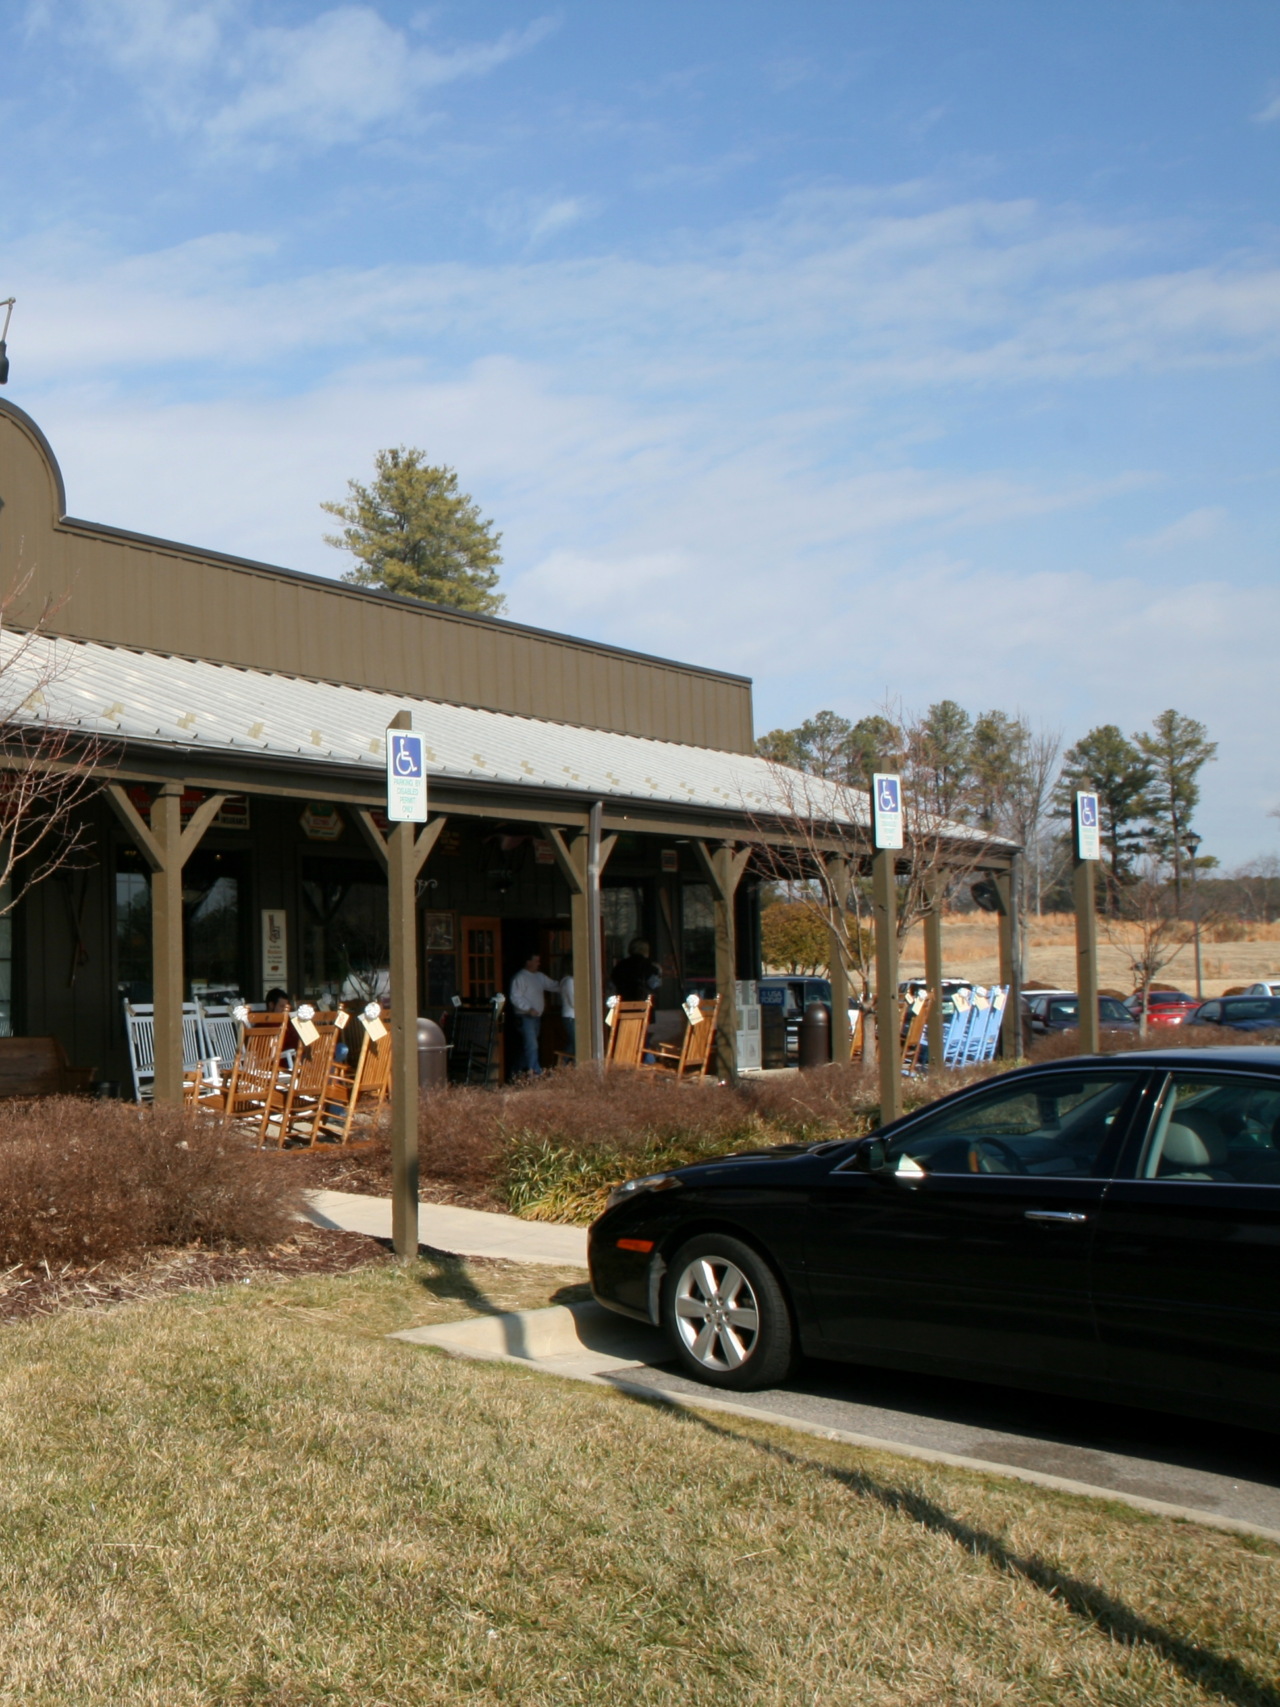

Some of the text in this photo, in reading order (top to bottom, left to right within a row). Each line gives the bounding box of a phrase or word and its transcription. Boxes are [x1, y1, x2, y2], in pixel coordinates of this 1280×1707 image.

[393, 778, 422, 787] PARKING BY
[396, 787, 419, 796] DISABLED
[399, 796, 416, 804] PERMIT
[402, 805, 414, 814] ONLY
[760, 996, 783, 1004] TODAY
